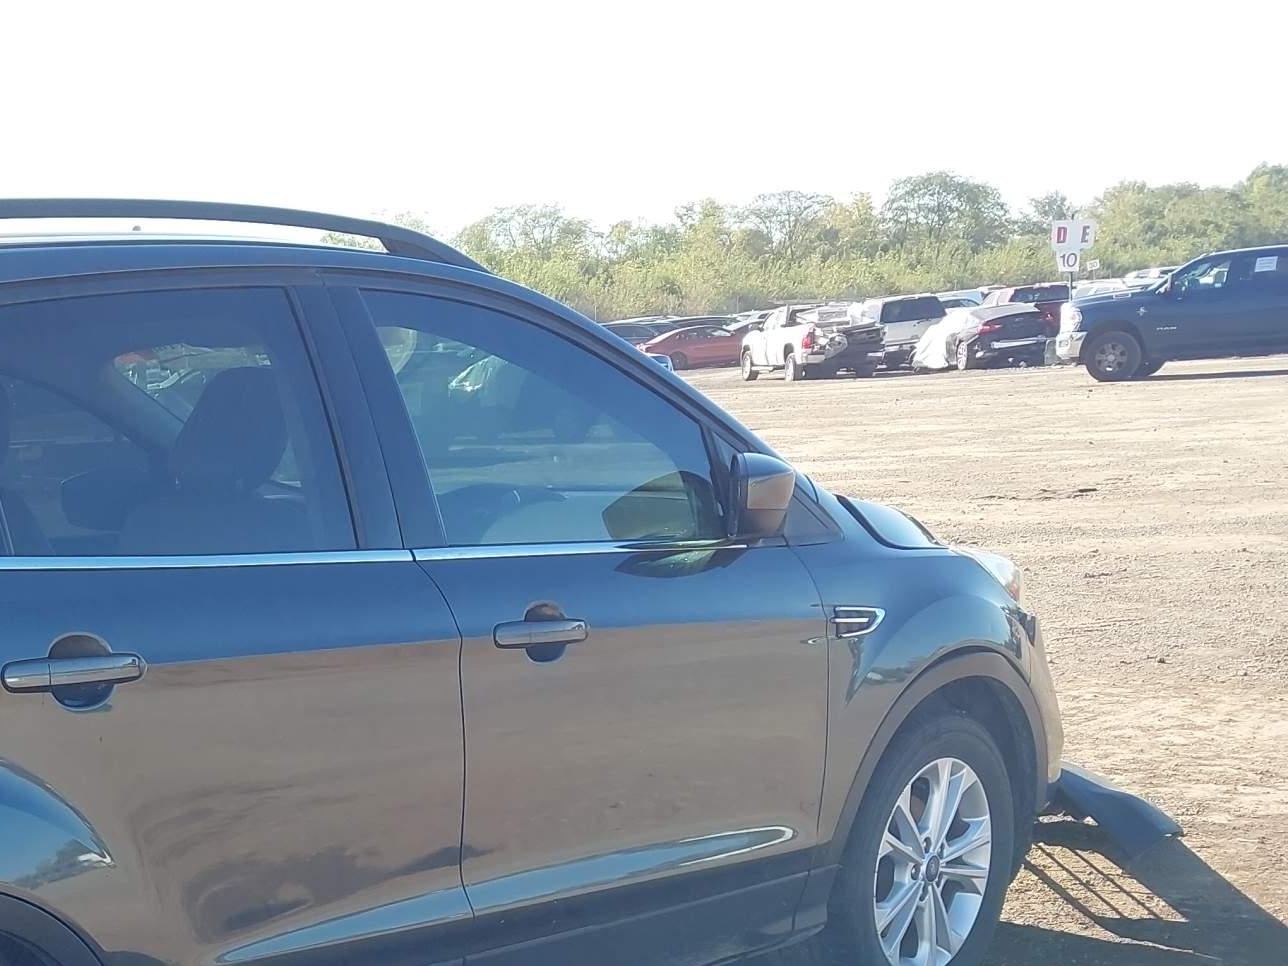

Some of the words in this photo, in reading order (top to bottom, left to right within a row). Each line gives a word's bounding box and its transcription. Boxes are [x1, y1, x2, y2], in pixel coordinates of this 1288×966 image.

[1056, 226, 1068, 244] D
[1080, 225, 1091, 244] E
[1059, 252, 1078, 268] 10
